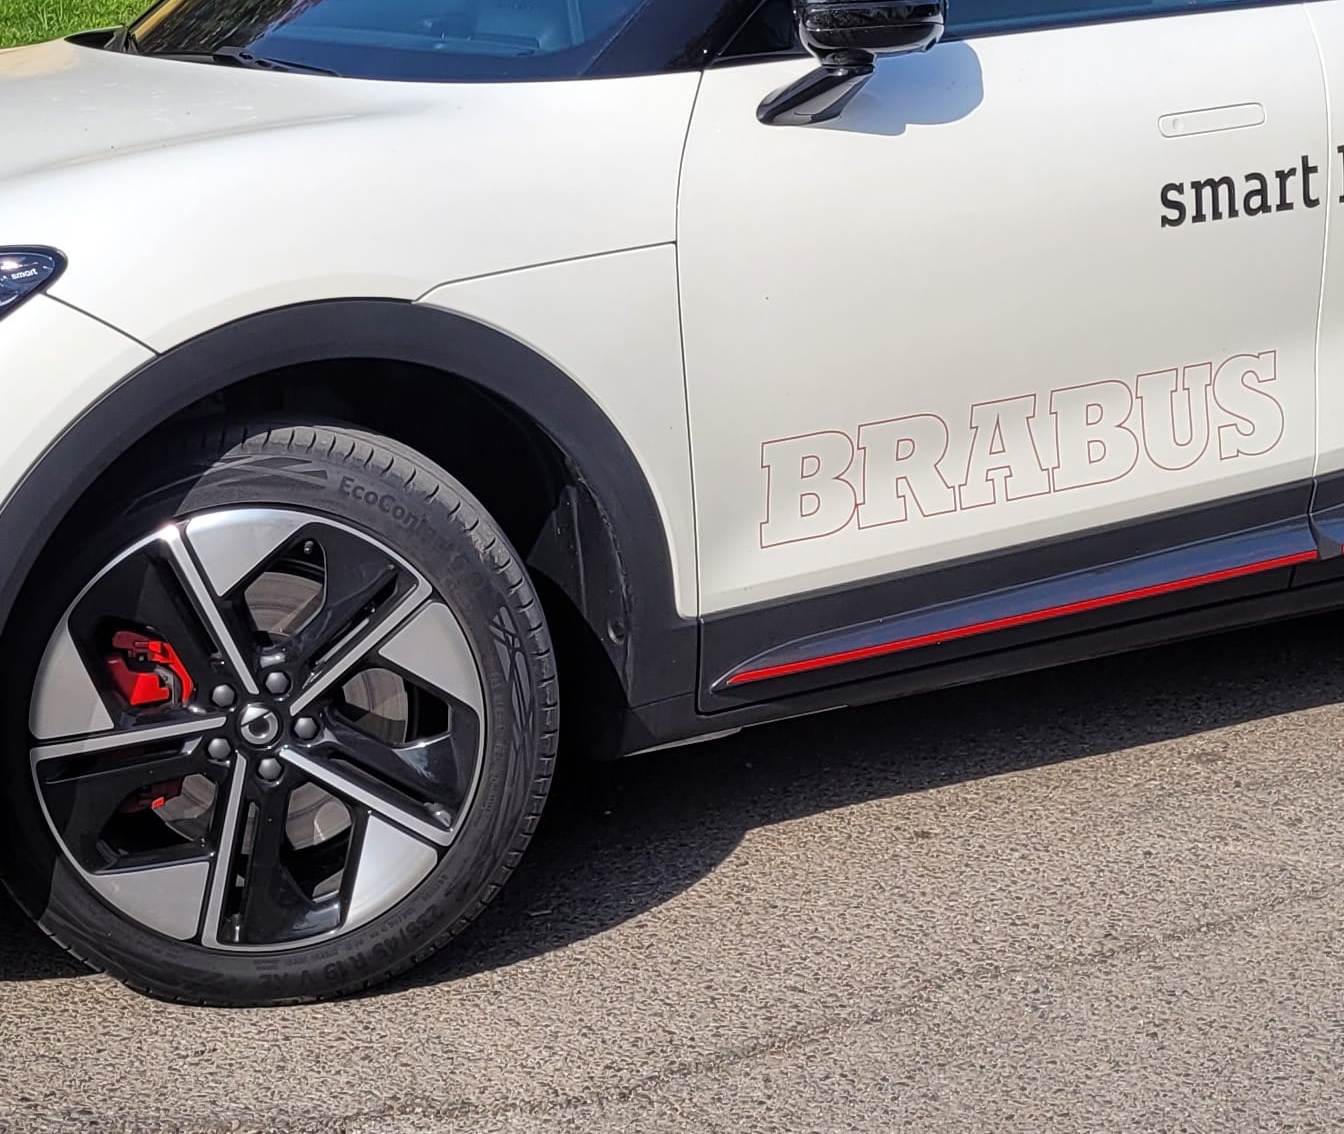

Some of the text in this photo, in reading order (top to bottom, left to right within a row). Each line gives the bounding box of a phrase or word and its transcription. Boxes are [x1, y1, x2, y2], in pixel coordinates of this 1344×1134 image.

[1159, 154, 1321, 228] smart
[11, 268, 39, 280] smart
[759, 349, 1286, 549] BRABUS
